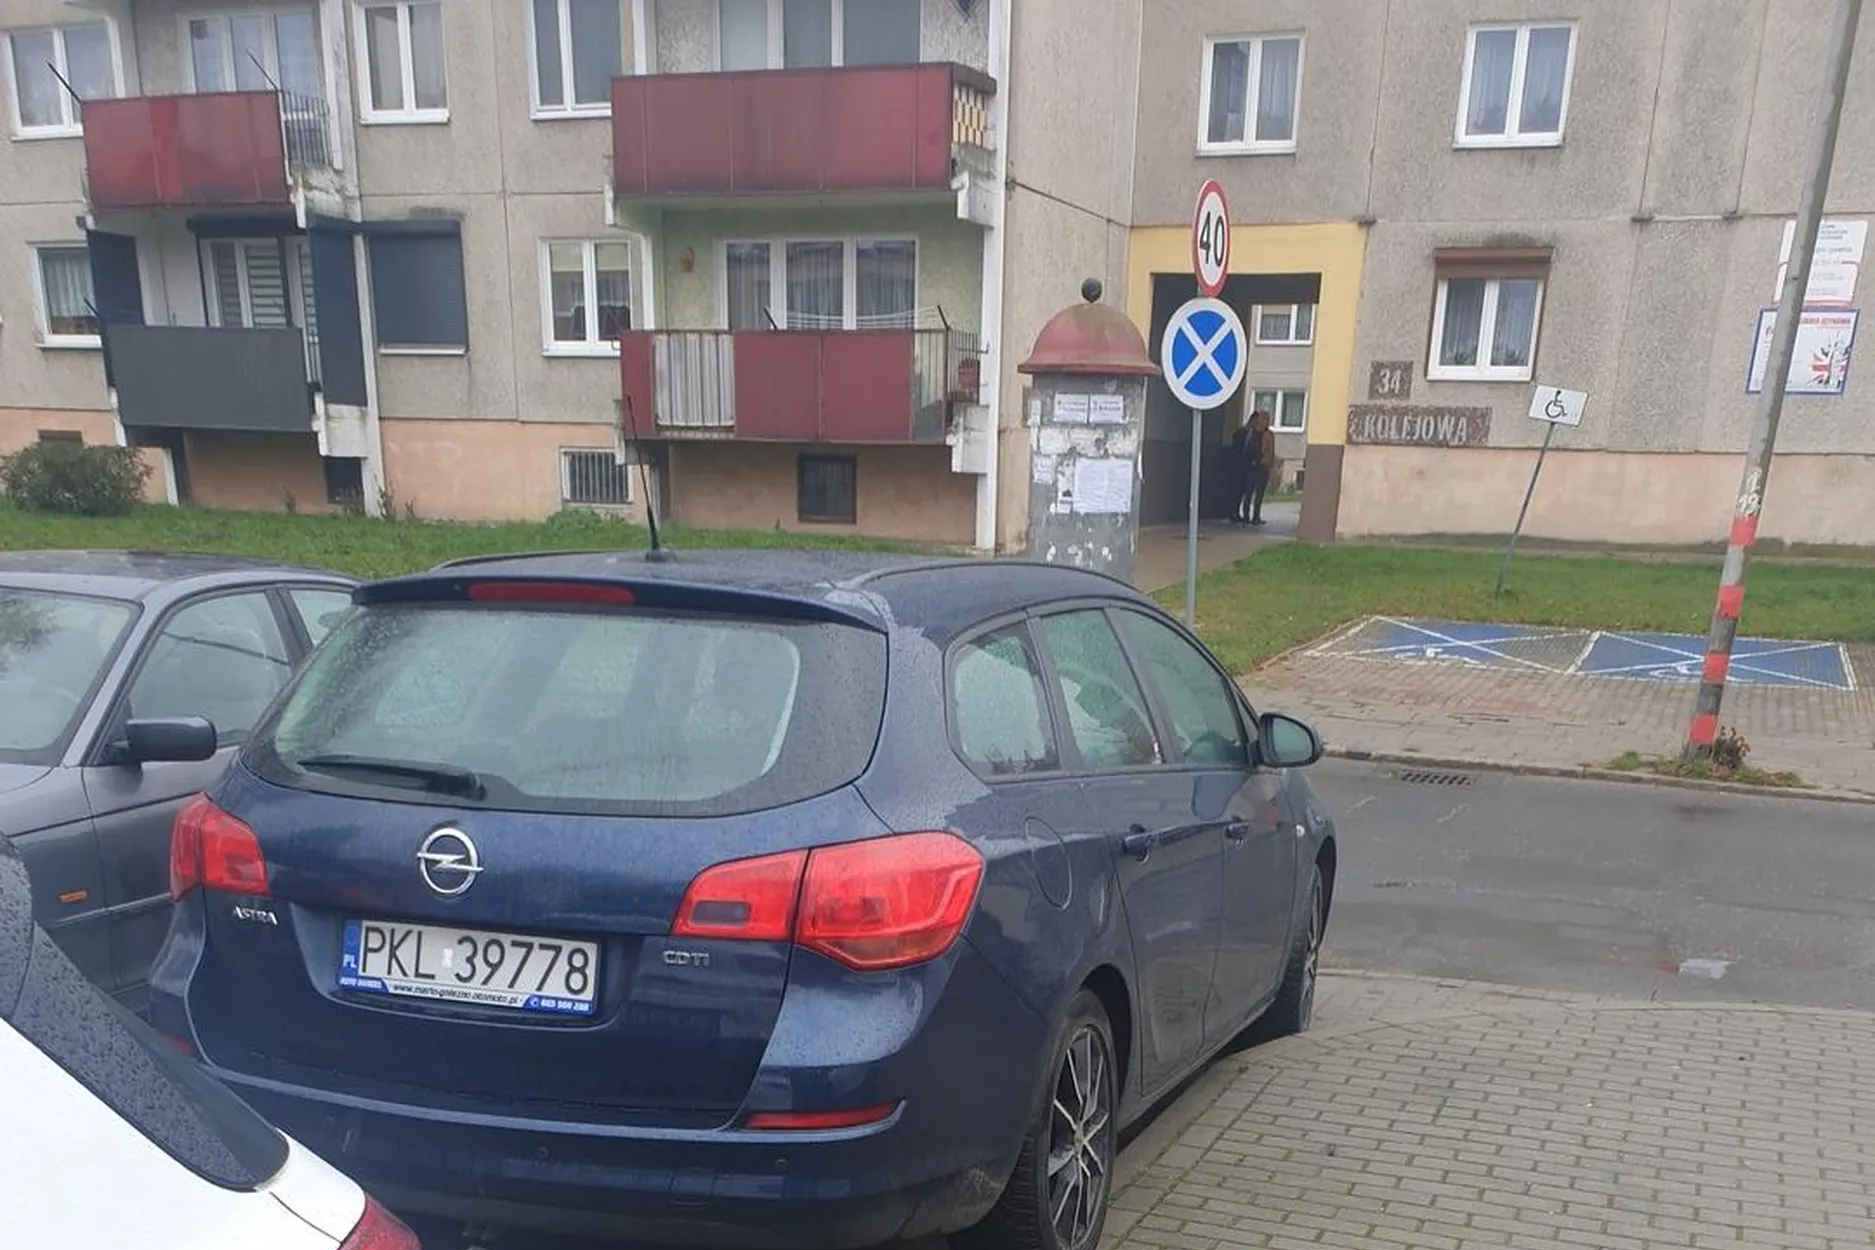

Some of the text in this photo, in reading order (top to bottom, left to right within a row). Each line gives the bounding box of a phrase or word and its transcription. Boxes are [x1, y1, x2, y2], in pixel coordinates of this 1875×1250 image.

[1199, 210, 1225, 267] 40
[1376, 367, 1401, 395] 34
[1364, 412, 1468, 445] KOLEJOWA
[233, 906, 278, 925] ASTRA
[343, 954, 357, 969] PL
[361, 926, 591, 995] PKL 39778
